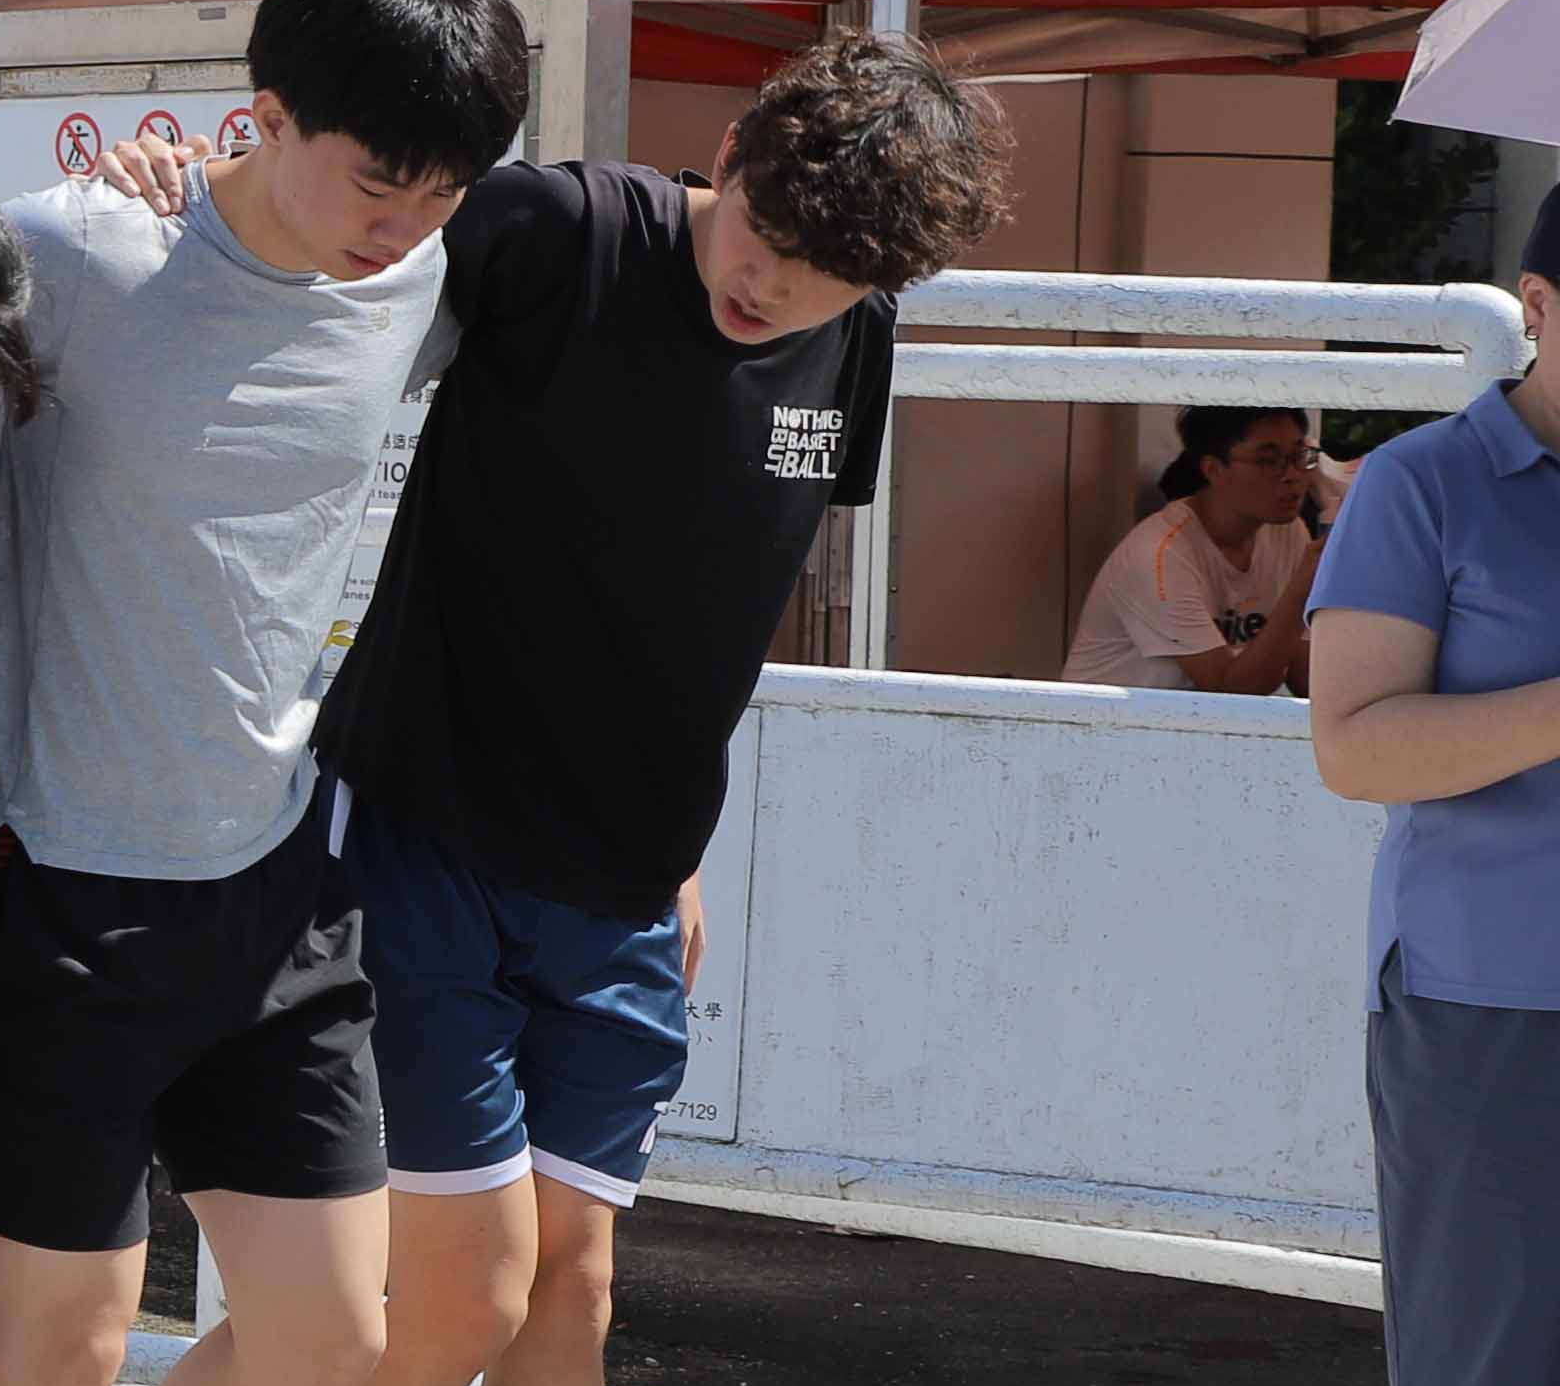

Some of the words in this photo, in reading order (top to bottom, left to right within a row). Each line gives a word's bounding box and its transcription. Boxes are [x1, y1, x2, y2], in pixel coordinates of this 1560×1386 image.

[764, 428, 789, 478] BUT
[780, 450, 837, 480] BALL
[1214, 609, 1267, 646] ike
